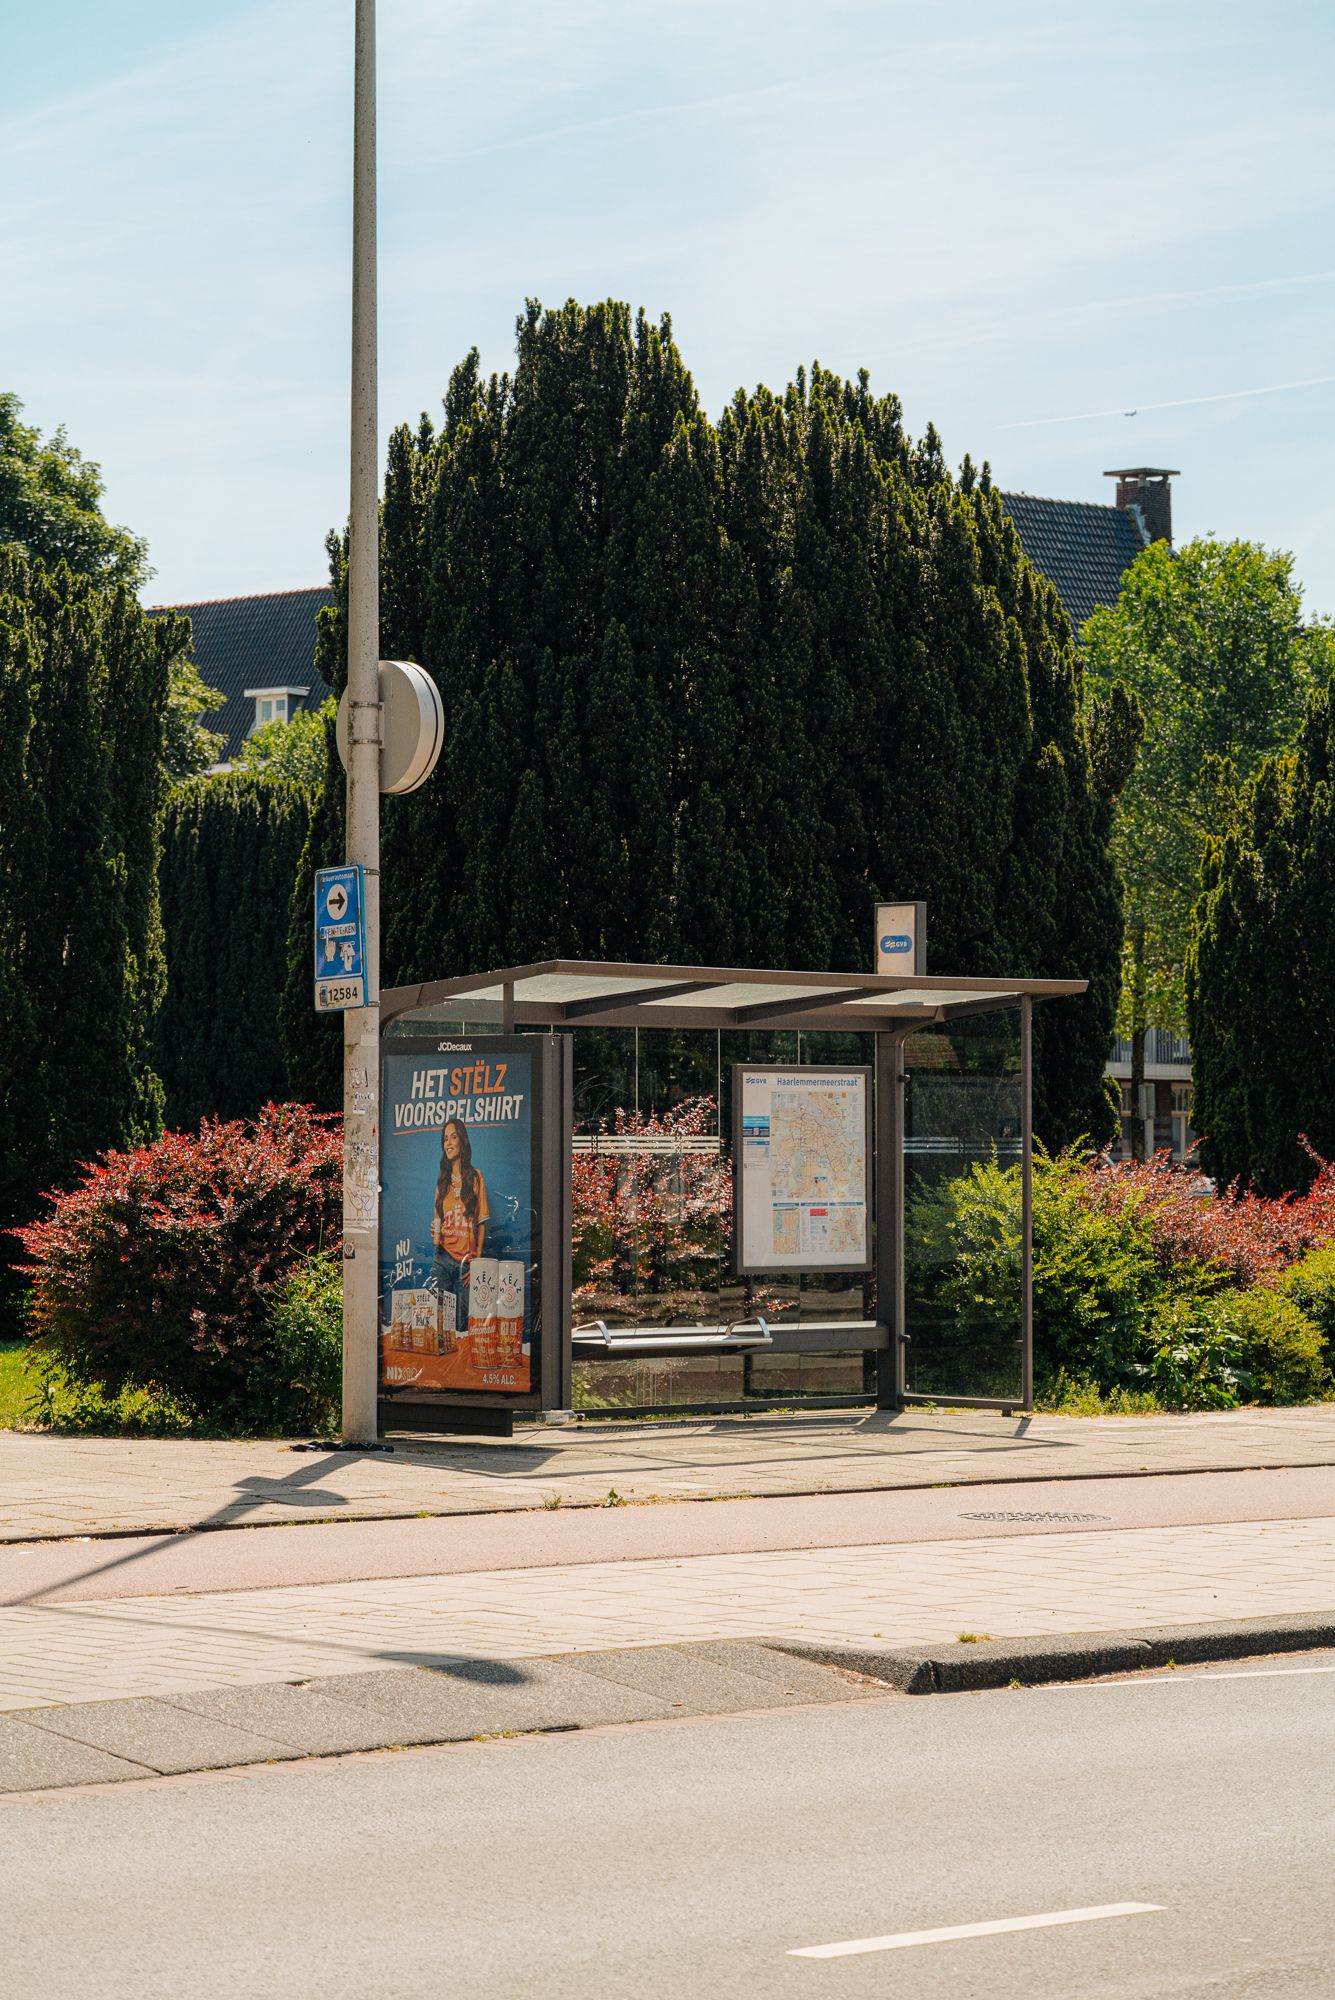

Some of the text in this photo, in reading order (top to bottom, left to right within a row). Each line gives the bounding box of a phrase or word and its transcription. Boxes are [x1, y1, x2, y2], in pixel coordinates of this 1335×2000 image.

[329, 986, 358, 1001] 12584
[437, 1042, 473, 1052] JCDecaux
[411, 1059, 508, 1099] HET STËLZ
[777, 1077, 858, 1087] Haarlemmermeerstraat
[394, 1094, 524, 1128] VOORSPELSHIRT
[395, 1238, 410, 1261] NU
[395, 1258, 414, 1280] BIJ
[482, 1373, 516, 1385] 4.5% ALC.
